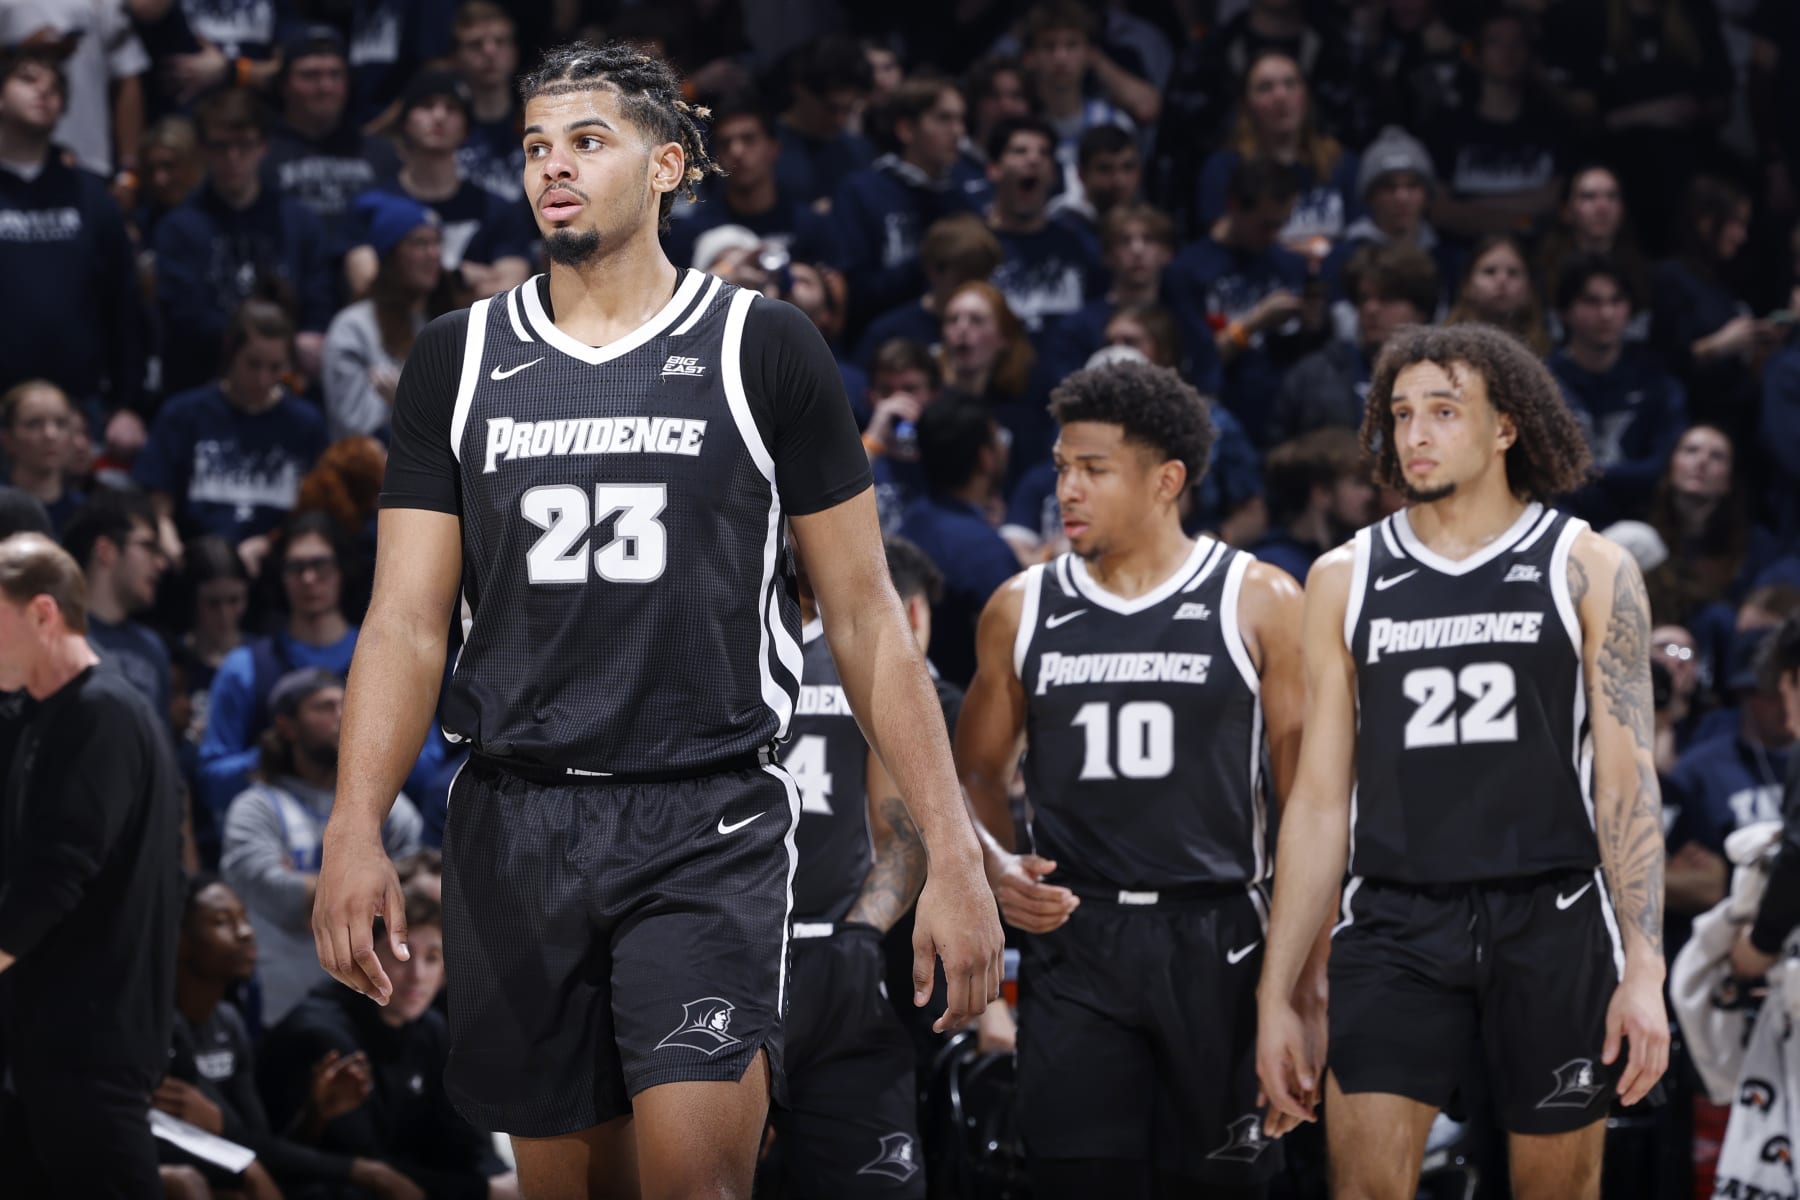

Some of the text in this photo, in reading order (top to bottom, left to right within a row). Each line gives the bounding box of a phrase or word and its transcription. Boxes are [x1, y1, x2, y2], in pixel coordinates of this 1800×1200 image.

[662, 363, 706, 374] EAST
[667, 355, 699, 366] BIG
[483, 416, 708, 474] PROVIDENCE
[520, 483, 668, 585] 23
[1366, 612, 1544, 664] PROVIDENCE
[1035, 651, 1212, 696] PROVIDENCE
[1402, 661, 1518, 750] 22
[1070, 701, 1174, 781] 10
[782, 734, 834, 815] 4
